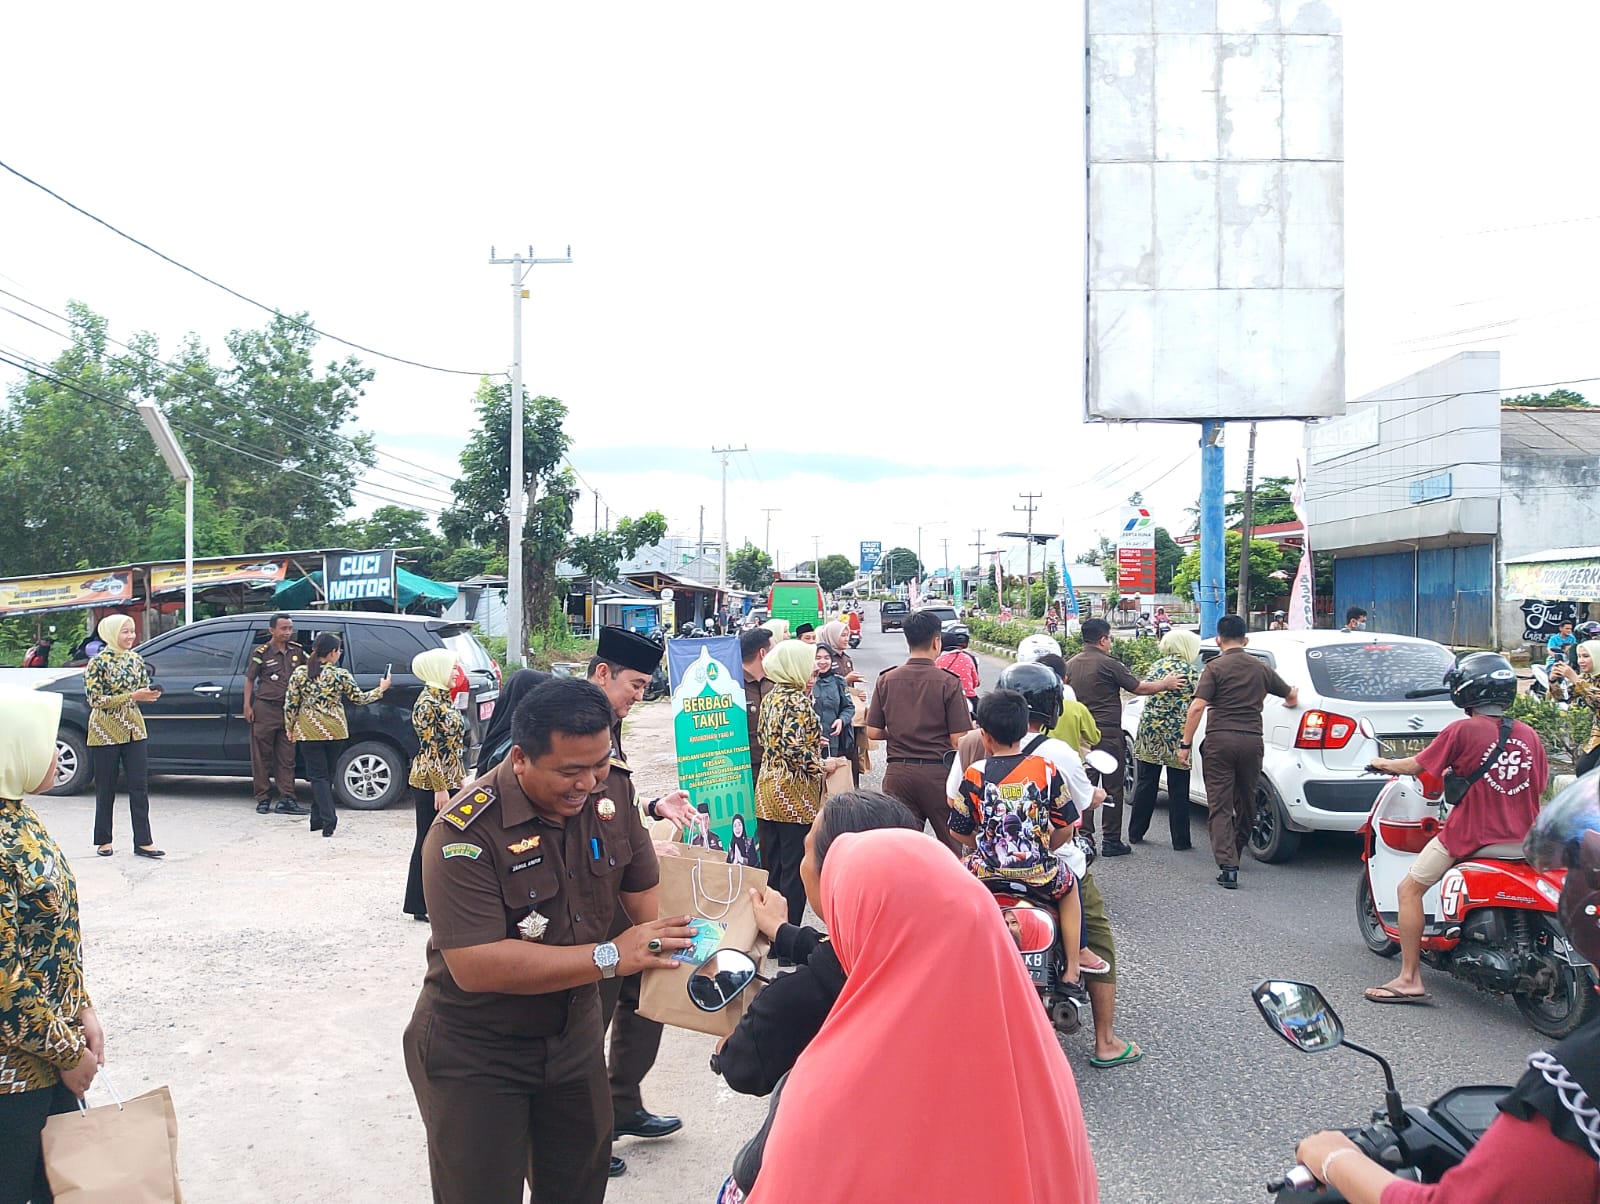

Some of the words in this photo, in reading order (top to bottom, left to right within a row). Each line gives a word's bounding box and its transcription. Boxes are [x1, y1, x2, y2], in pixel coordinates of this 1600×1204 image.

[339, 554, 381, 576] CUCI
[329, 577, 392, 600] MOTOR
[683, 694, 732, 713] BERBAGI
[692, 711, 730, 730] TAKJIL
[1001, 786, 1022, 799] PUBG
